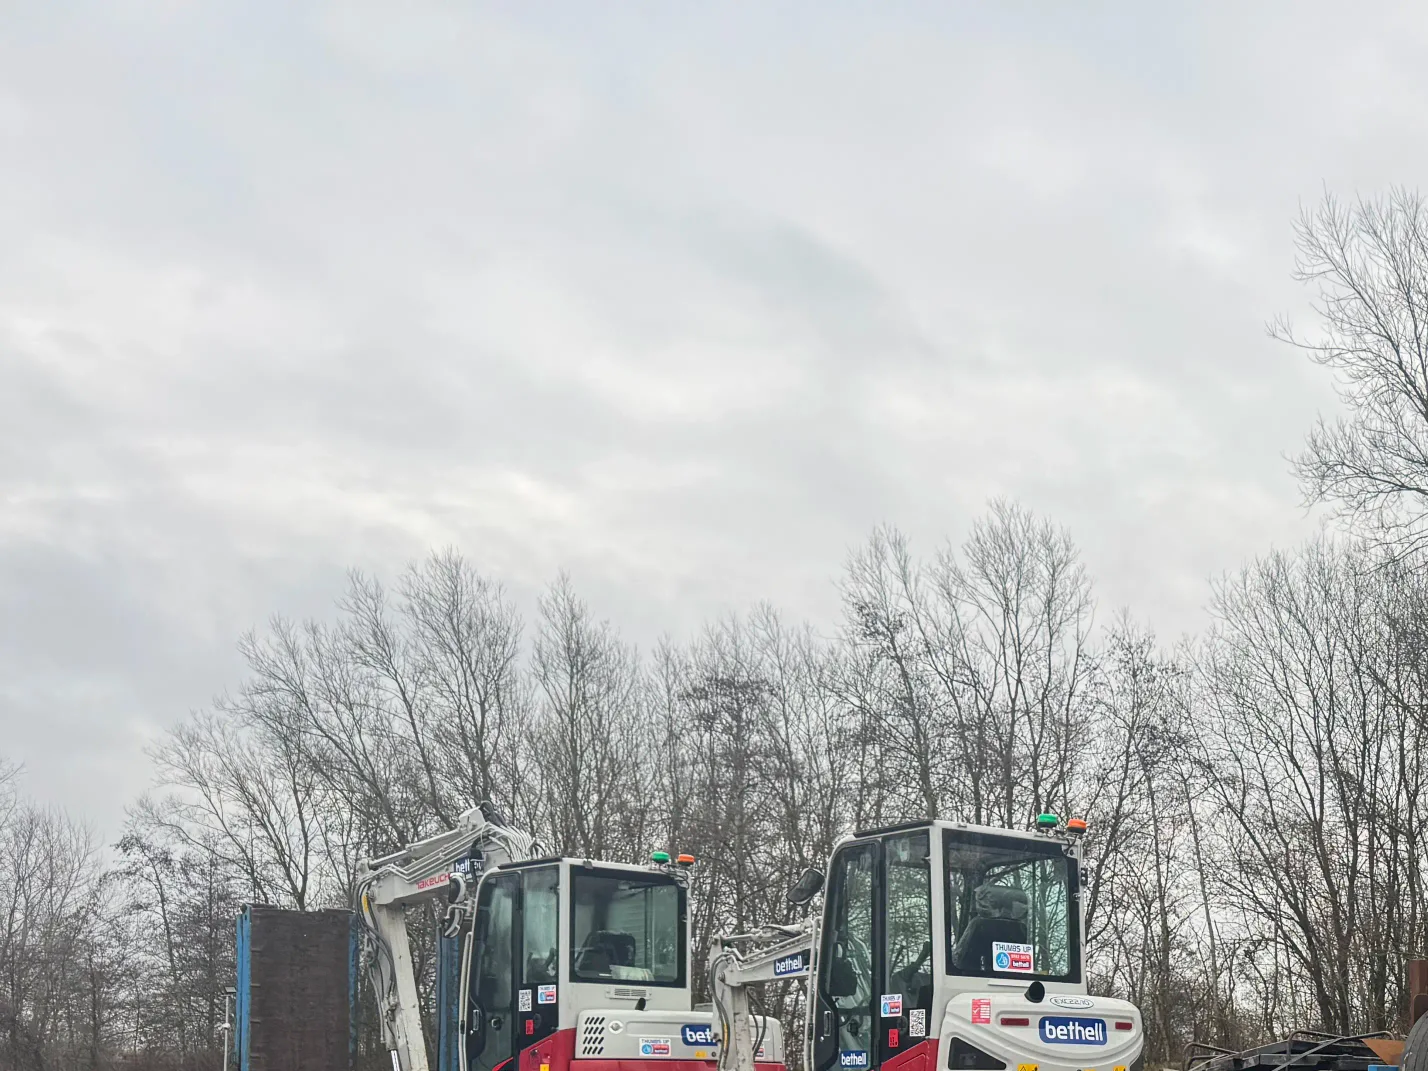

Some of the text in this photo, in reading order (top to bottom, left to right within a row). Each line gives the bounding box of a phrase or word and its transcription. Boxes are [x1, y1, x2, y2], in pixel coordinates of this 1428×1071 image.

[995, 943, 1021, 953] THUMBS
[775, 955, 803, 973] bethell
[1045, 1020, 1104, 1042] bethell
[841, 1052, 867, 1066] bethell
